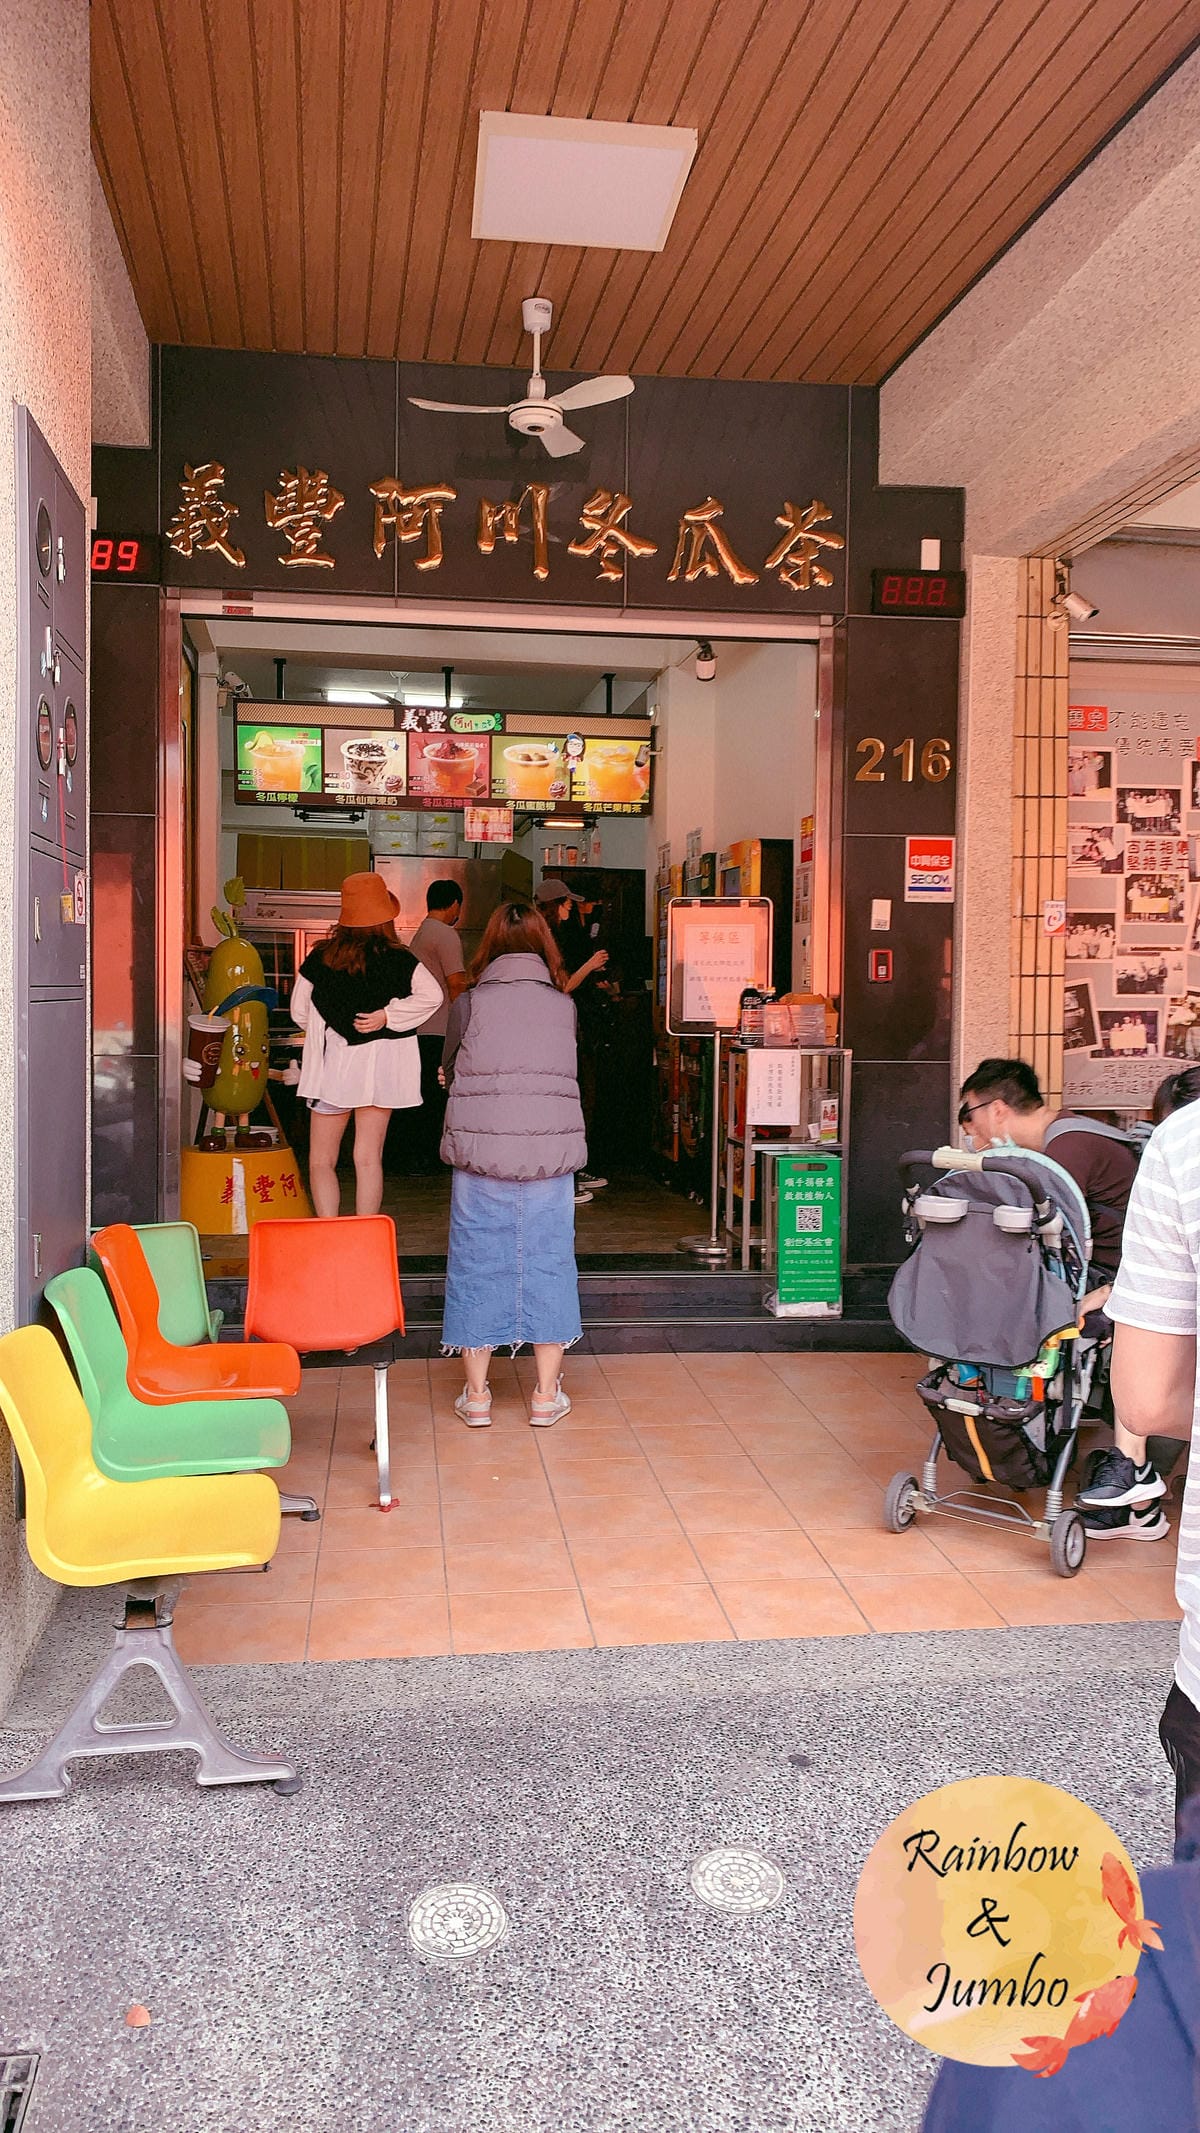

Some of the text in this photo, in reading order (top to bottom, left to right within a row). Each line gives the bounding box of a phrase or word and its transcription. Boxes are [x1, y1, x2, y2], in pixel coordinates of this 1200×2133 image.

[165, 460, 846, 591] 義豐阿川冬瓜茶
[401, 709, 447, 733] 義豐
[855, 738, 951, 783] 216
[255, 791, 299, 803] 冬瓜檸檬
[910, 854, 950, 868] 中興保全
[910, 874, 950, 885] SECOM
